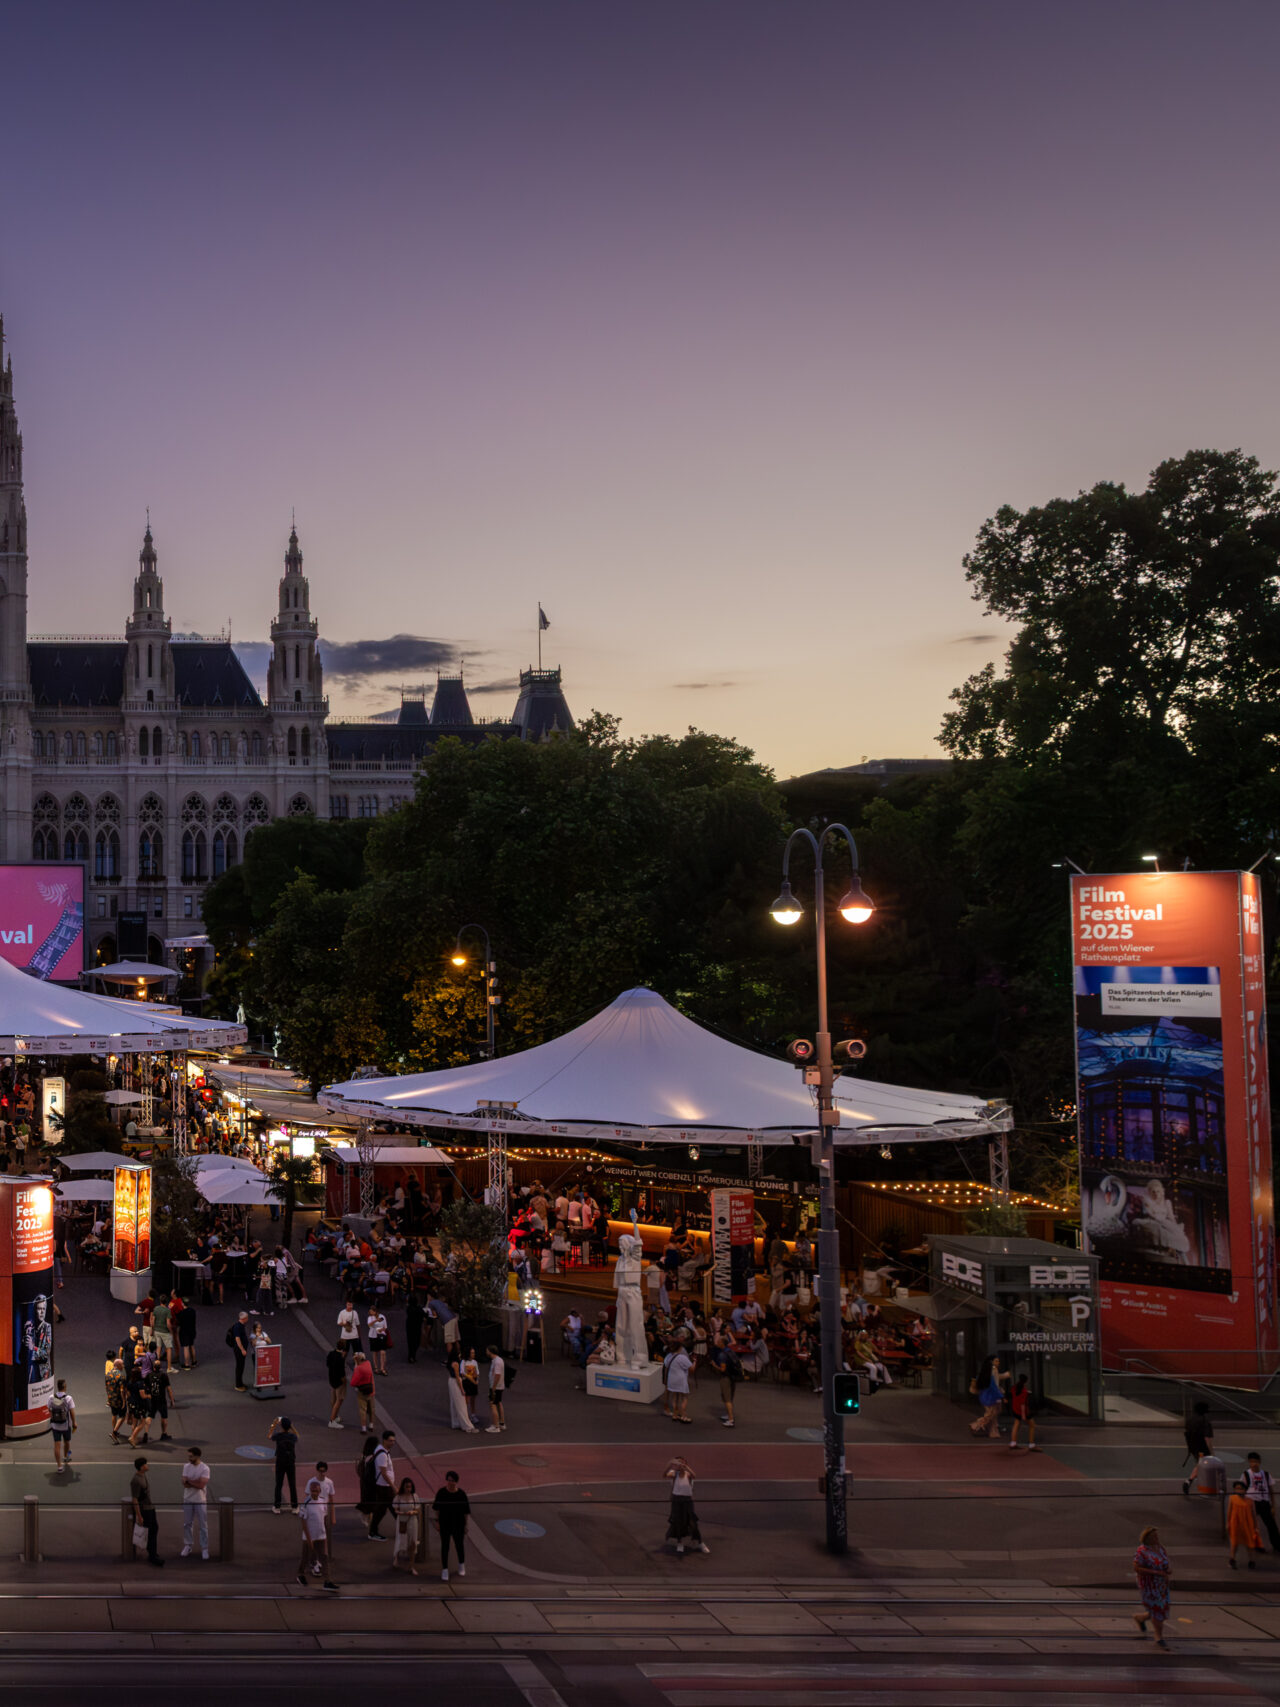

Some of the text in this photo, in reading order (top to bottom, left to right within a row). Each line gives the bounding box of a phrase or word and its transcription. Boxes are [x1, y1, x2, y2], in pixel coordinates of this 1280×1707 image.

[1079, 886, 1125, 903] Film
[1080, 903, 1163, 921] Festival
[1080, 923, 1133, 940] 2025
[1080, 943, 1155, 953] auf dem Wiener
[1081, 953, 1141, 962] Rathausplatz
[603, 1166, 638, 1177] WEINGUT
[638, 1169, 657, 1178] WIEN
[657, 1171, 692, 1182] COBENZL
[698, 1174, 754, 1188] RÖMERQUELLE
[755, 1181, 790, 1191] LOUNGE
[16, 1217, 43, 1231] 2025
[1030, 1265, 1091, 1284] BOE
[1071, 1303, 1091, 1328] P
[1009, 1332, 1095, 1342] PARKEN UNTERM
[1016, 1343, 1095, 1353] RATHAUSPLATZ
